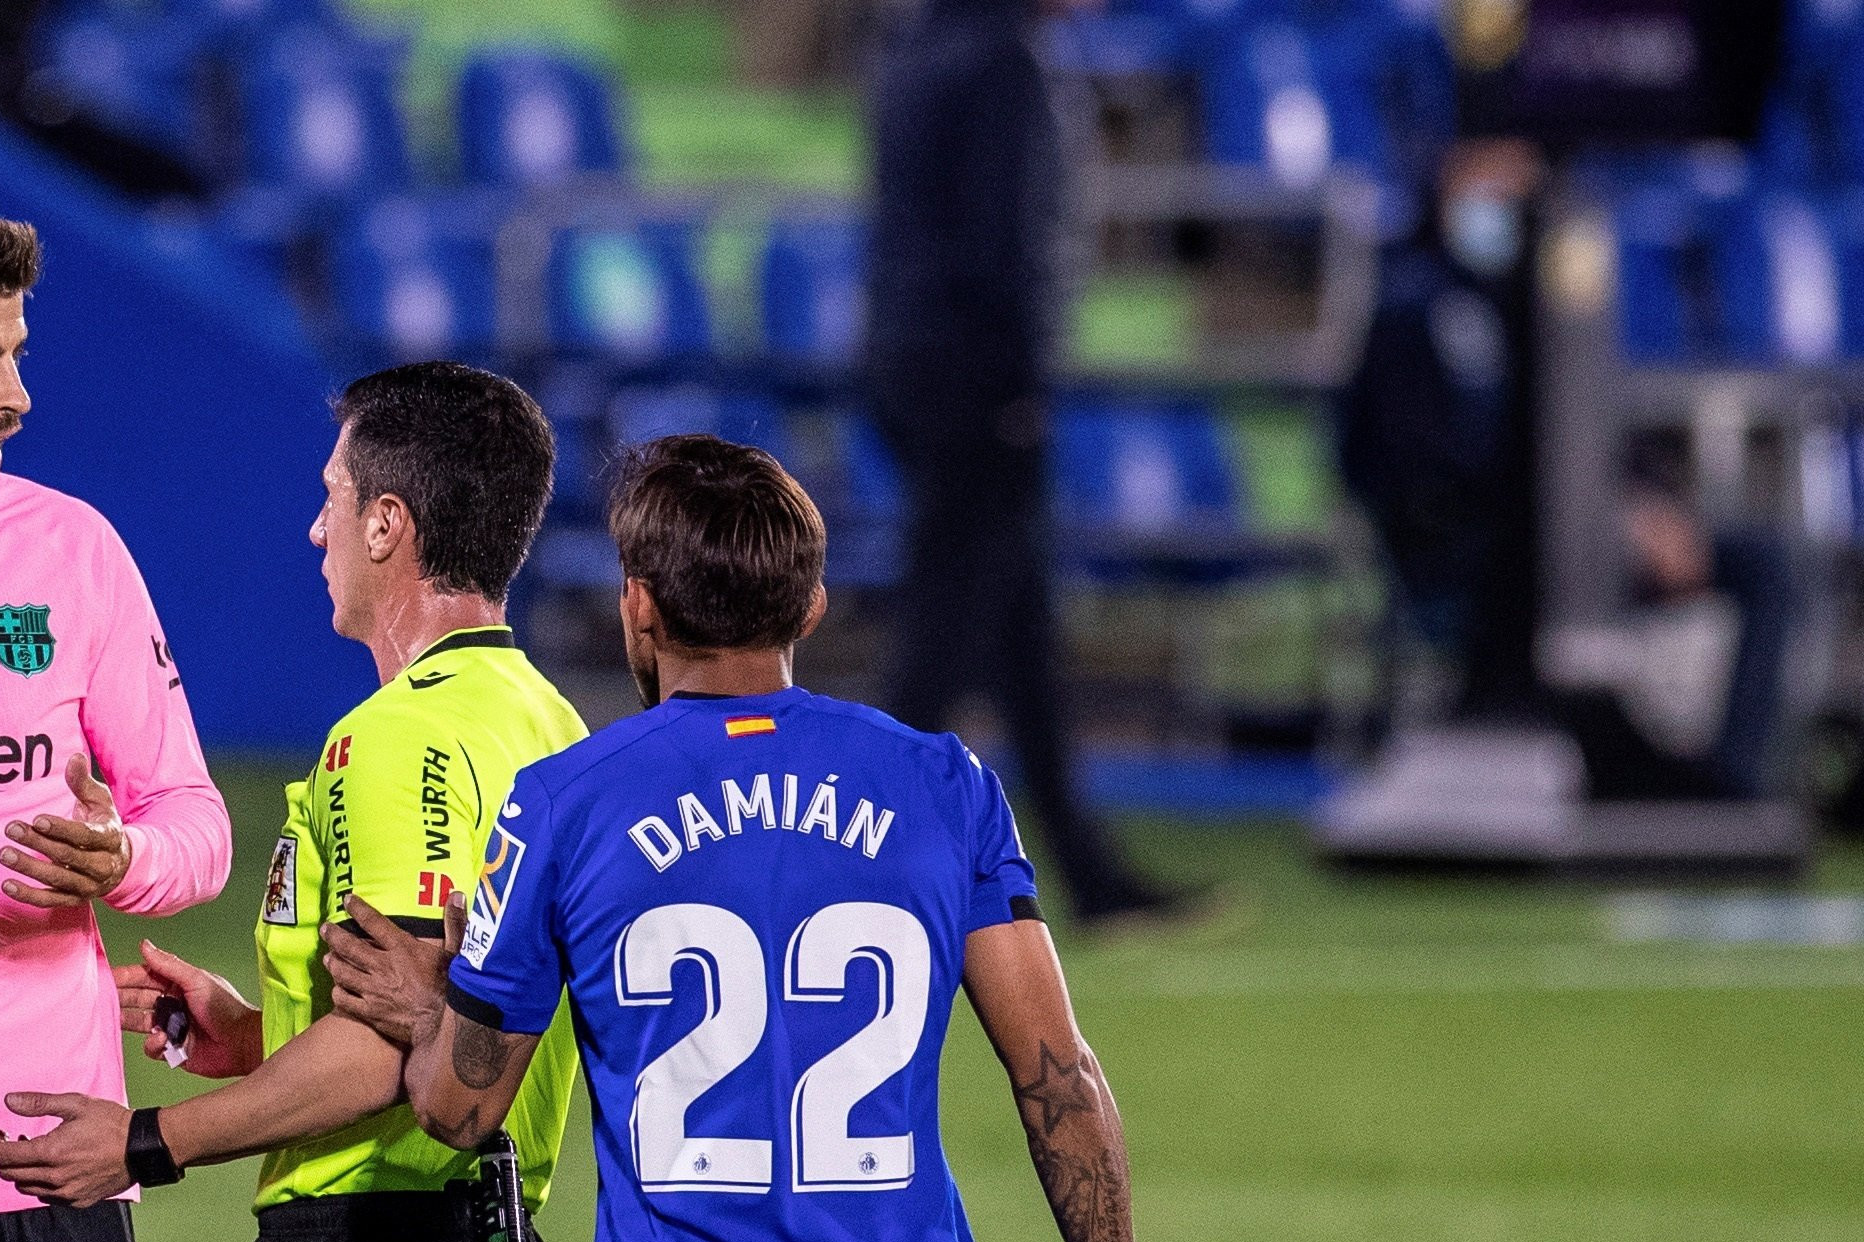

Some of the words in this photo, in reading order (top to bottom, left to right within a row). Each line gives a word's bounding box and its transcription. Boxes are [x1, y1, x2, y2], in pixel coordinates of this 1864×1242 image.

[10, 635, 34, 644] FCB
[420, 746, 451, 862] WÜRTH
[627, 773, 895, 873] DAMIÁN
[614, 901, 931, 1193] 22
